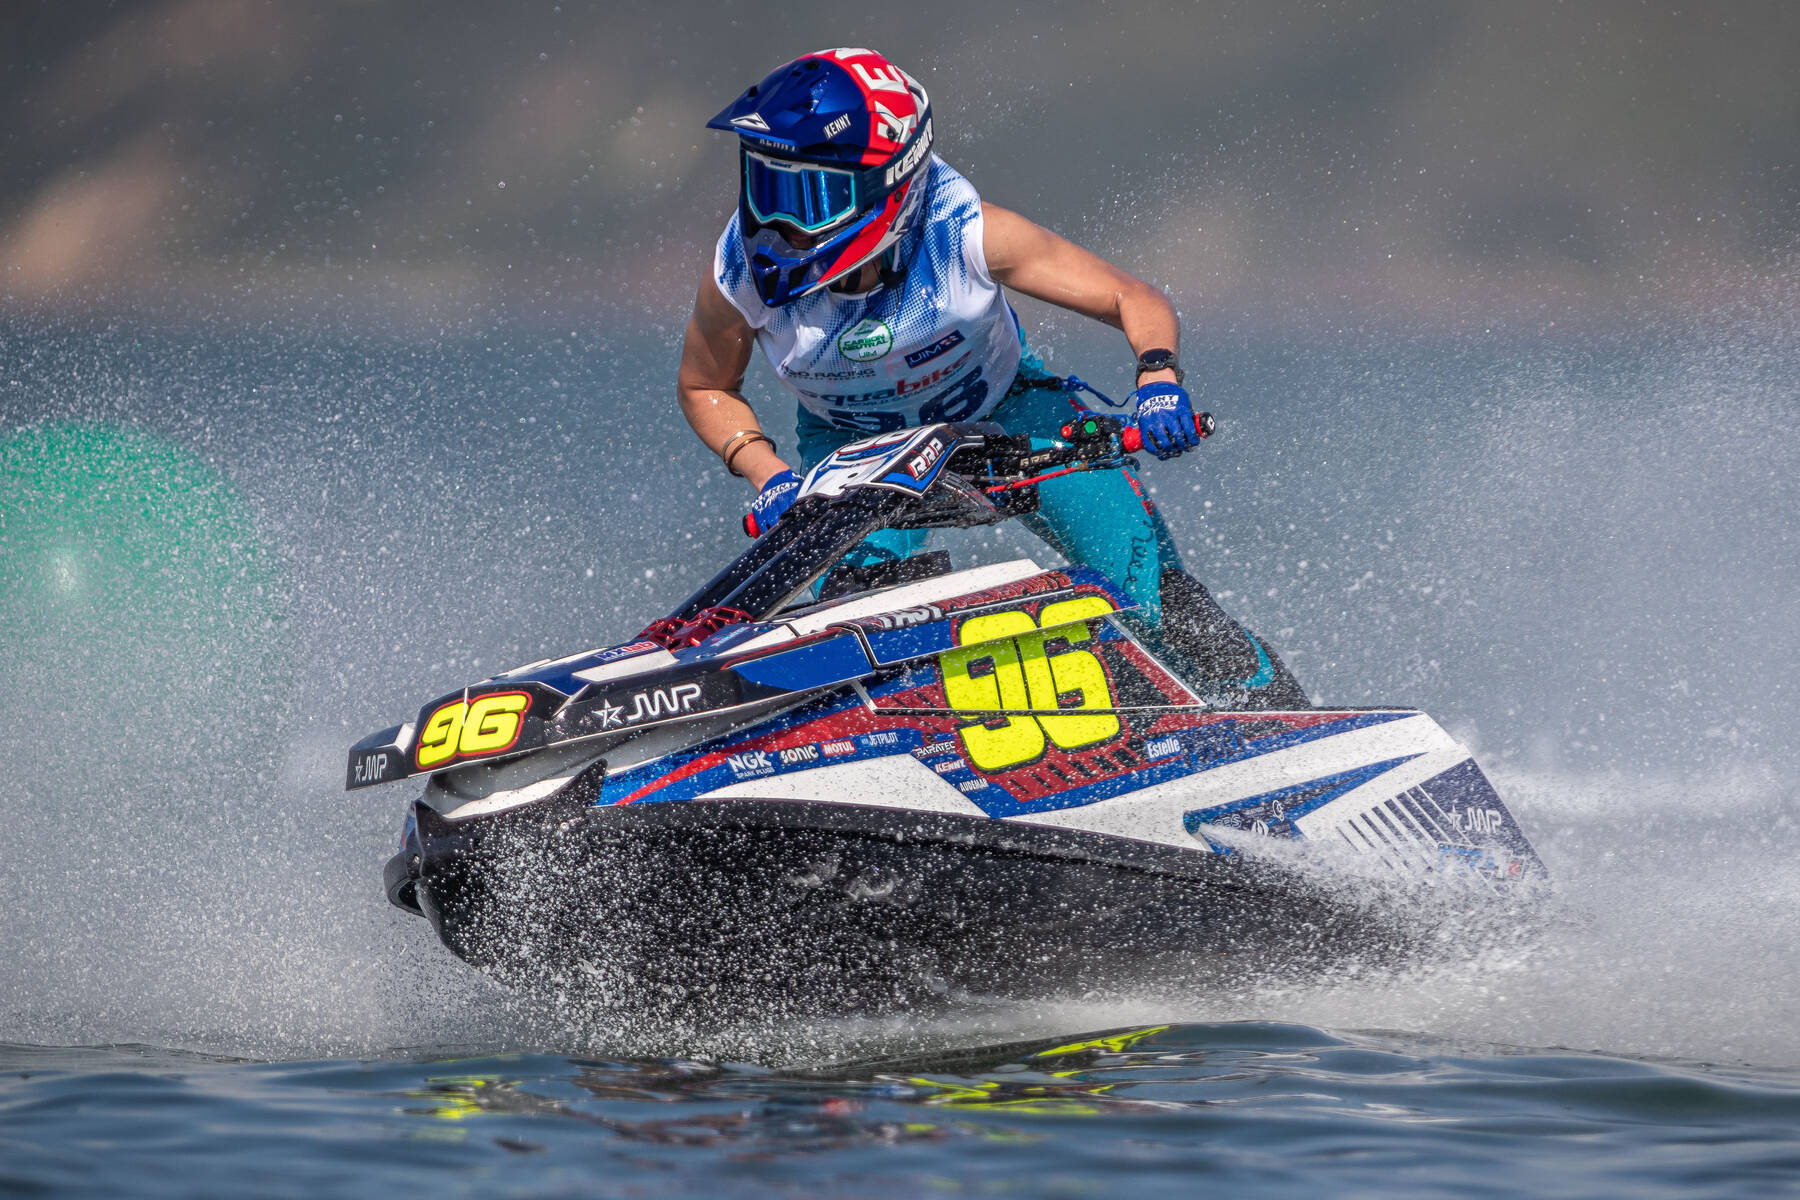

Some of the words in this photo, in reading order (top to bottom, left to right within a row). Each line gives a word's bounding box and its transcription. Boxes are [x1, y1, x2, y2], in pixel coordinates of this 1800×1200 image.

[823, 113, 851, 139] KENNY
[842, 339, 888, 351] NEUTRAL
[909, 344, 942, 364] UIM
[815, 368, 876, 378] RACING
[939, 594, 1120, 770] 96
[626, 683, 701, 722] JWP
[417, 693, 529, 767] 96
[868, 732, 899, 747] JETPILOT
[780, 744, 819, 764] SONIC
[823, 741, 855, 755] MOTUL
[1146, 738, 1181, 759] Estelle
[727, 750, 772, 774] NGK
[1464, 807, 1502, 834] JWP
